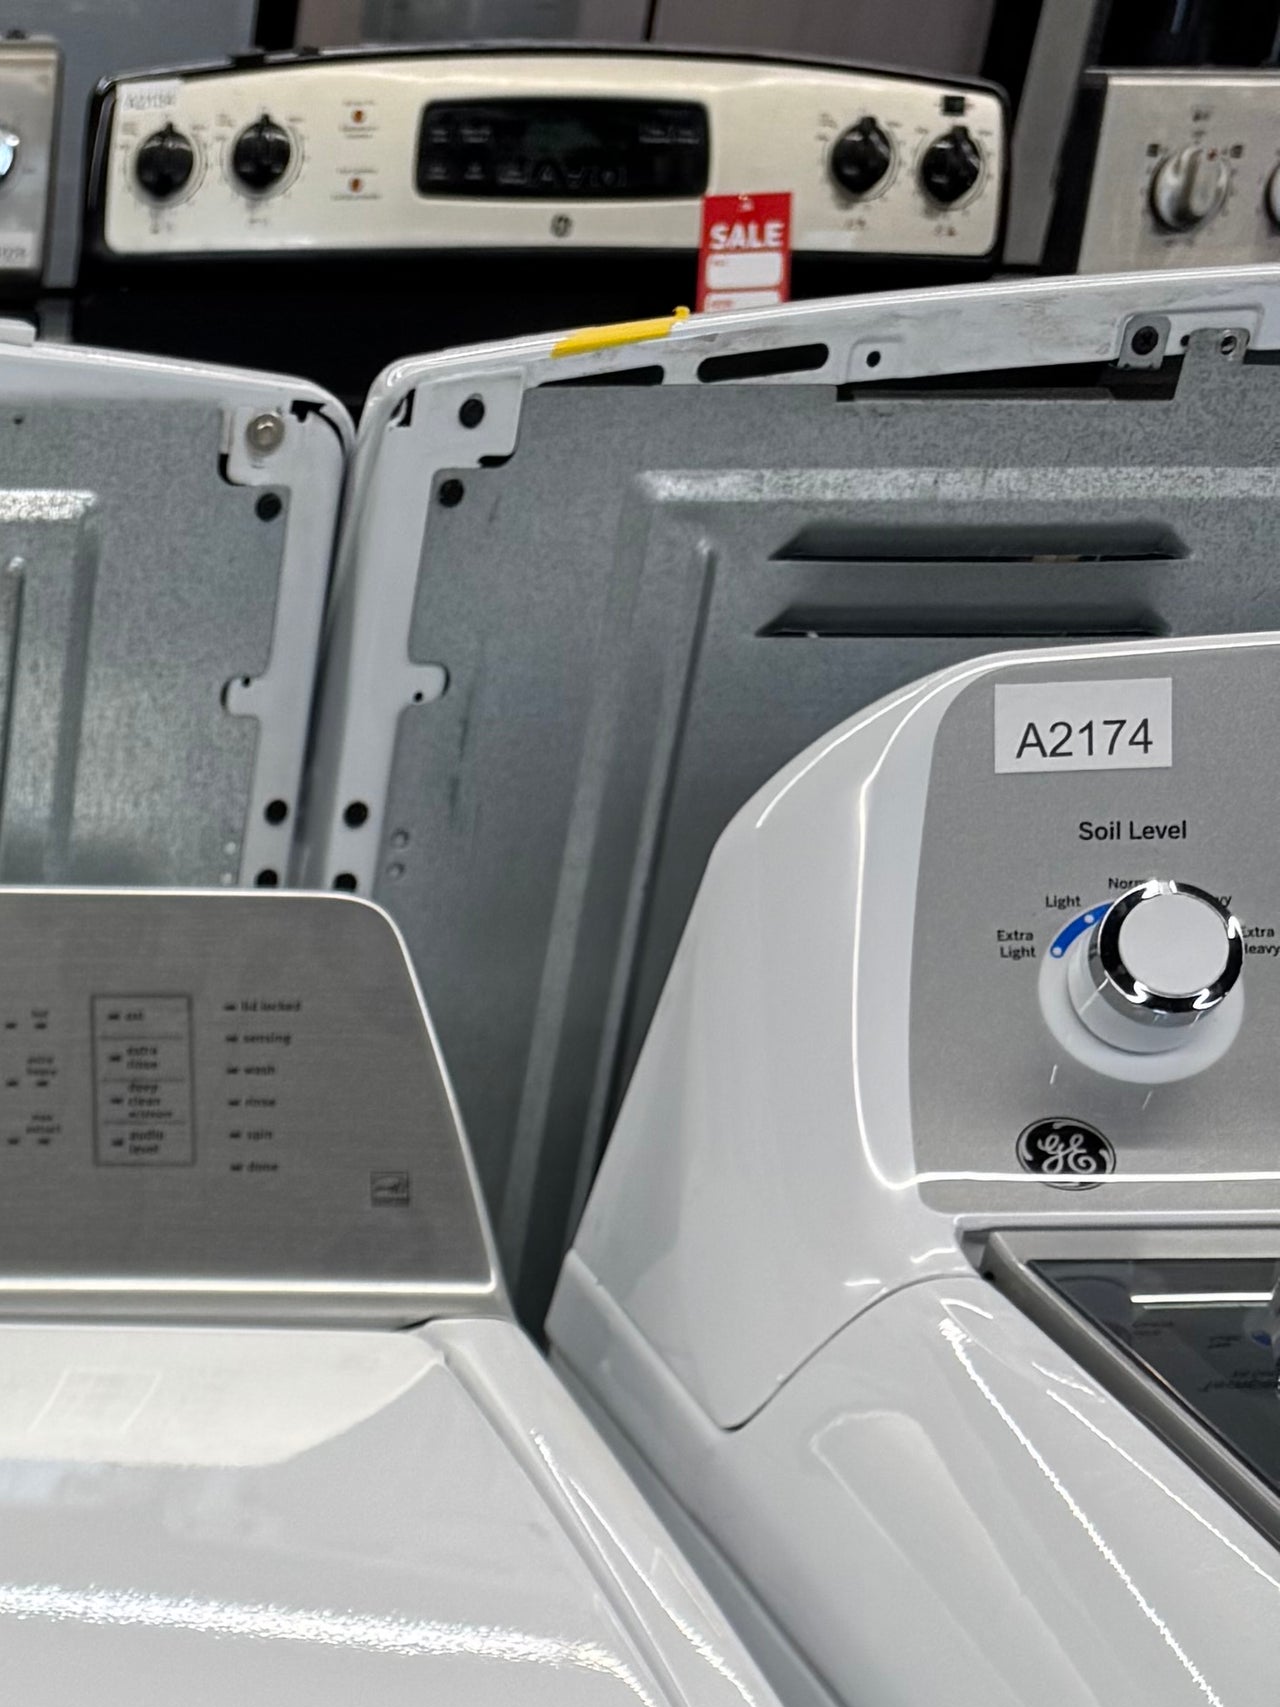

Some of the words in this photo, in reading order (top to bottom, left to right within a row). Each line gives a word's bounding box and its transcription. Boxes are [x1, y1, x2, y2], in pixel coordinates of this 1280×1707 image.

[709, 221, 785, 250] SALE
[1015, 717, 1154, 760] A2174
[1078, 820, 1122, 842] Soil
[1128, 819, 1188, 841] Level
[1044, 894, 1082, 911] Light
[996, 929, 1035, 943] Extra
[999, 945, 1037, 961] Light
